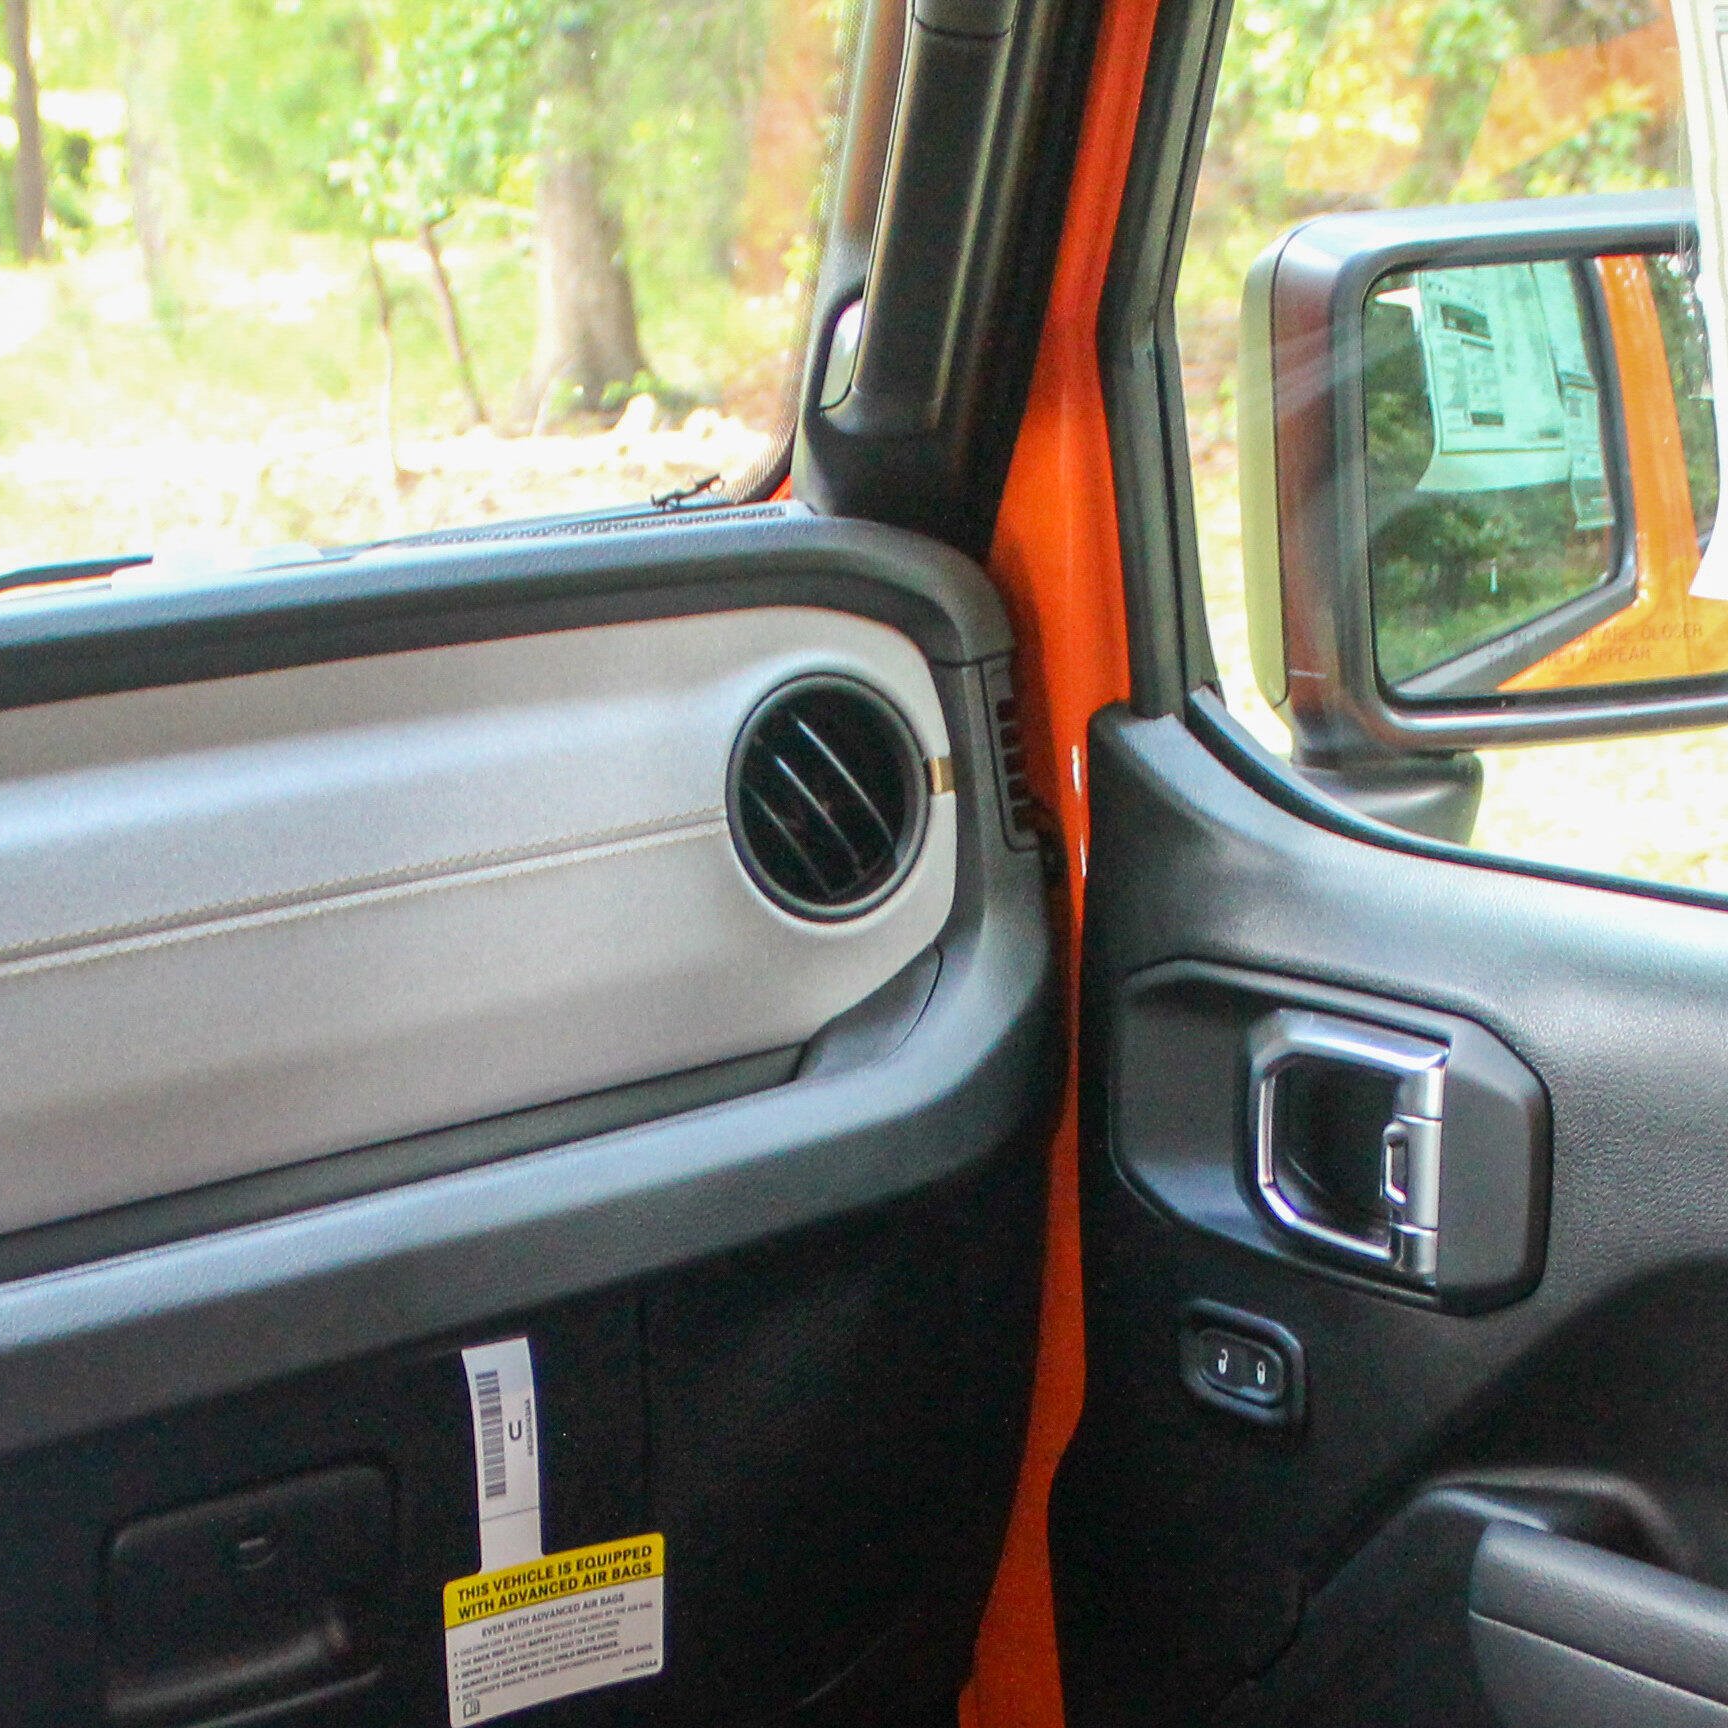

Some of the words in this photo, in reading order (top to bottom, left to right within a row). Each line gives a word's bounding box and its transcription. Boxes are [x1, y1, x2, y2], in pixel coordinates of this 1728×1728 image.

[508, 1420, 522, 1441] U
[457, 1581, 489, 1603] THIS
[493, 1567, 554, 1592] VEHICLE
[558, 1562, 571, 1575] IS
[576, 1545, 652, 1571] EQUIPPED
[458, 1599, 495, 1621] WITH
[499, 1578, 578, 1611] ADVANCED
[582, 1570, 607, 1587] AIR
[611, 1561, 652, 1580] BAGS
[481, 1622, 505, 1638] EVEN
[506, 1614, 530, 1630] WITH
[531, 1603, 580, 1623] ADVANCED
[582, 1597, 597, 1611] AIR
[599, 1592, 625, 1607] BAGS
